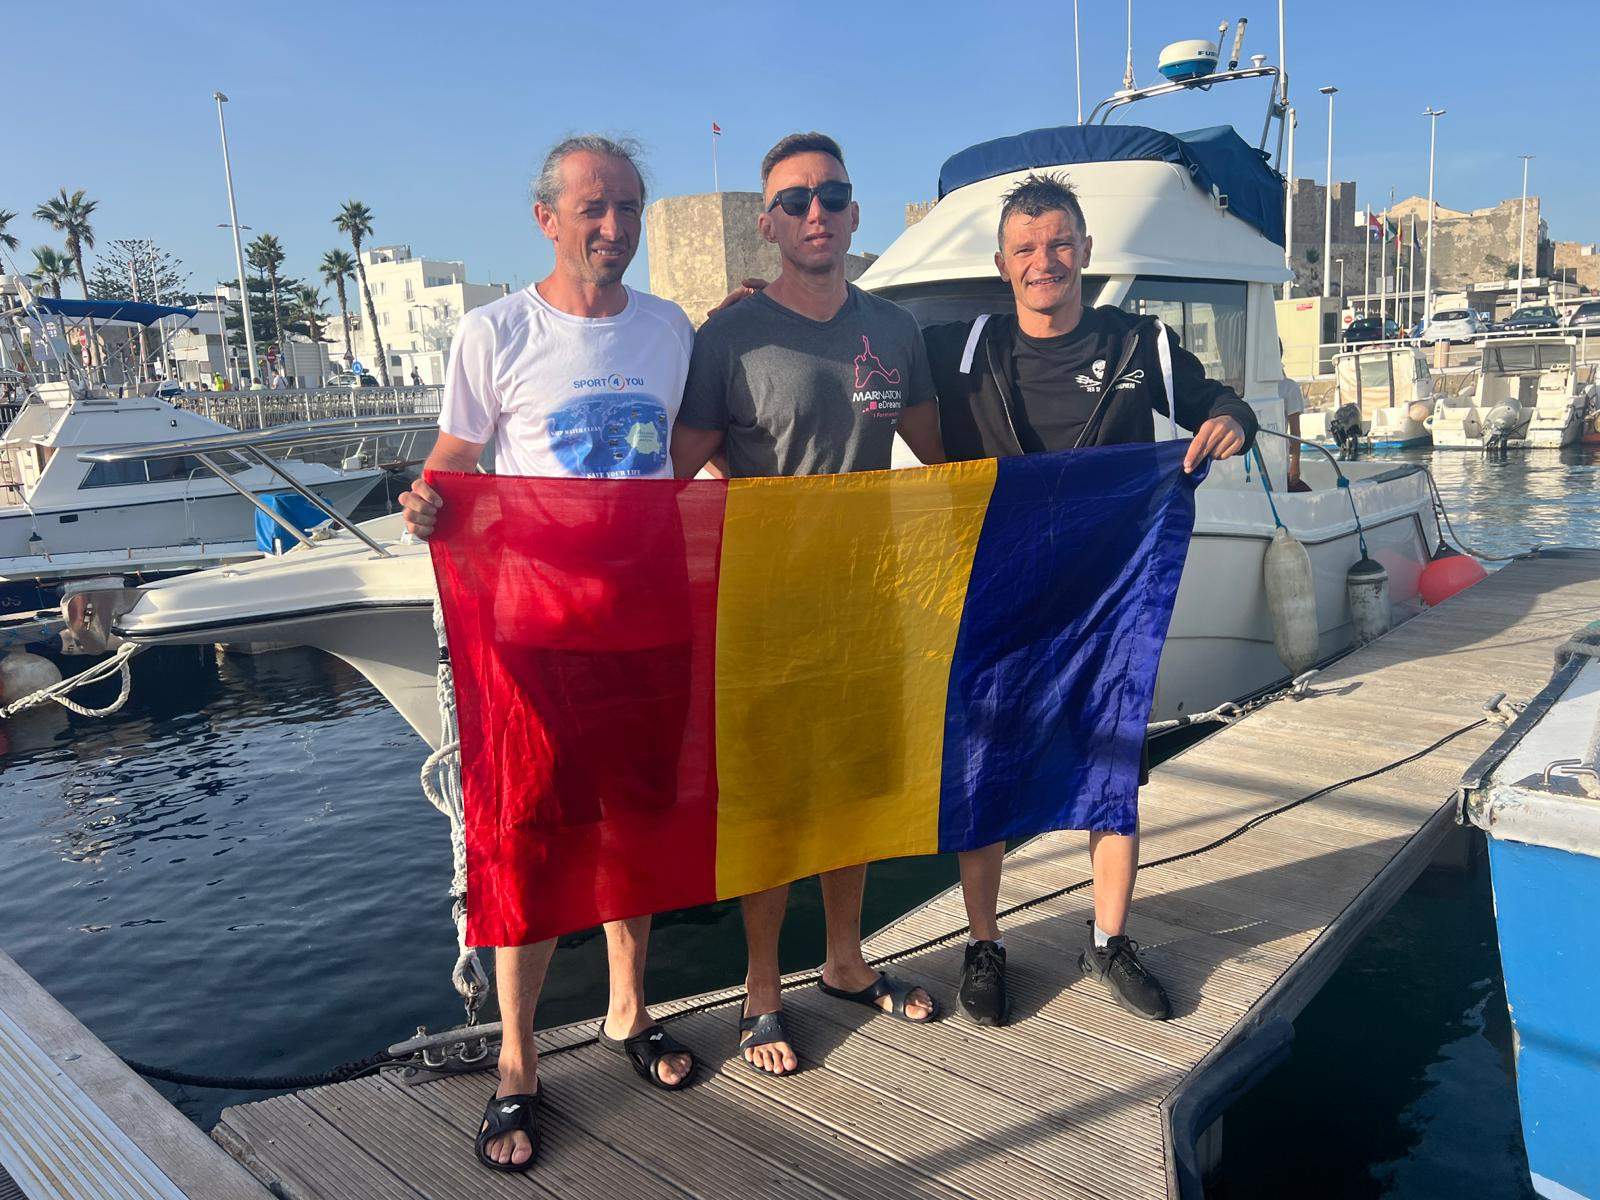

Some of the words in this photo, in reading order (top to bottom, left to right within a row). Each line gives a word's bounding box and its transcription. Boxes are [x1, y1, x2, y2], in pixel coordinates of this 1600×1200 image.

[573, 378, 608, 389] SPORT
[613, 377, 620, 386] 4
[625, 376, 645, 386] YOU
[852, 390, 902, 401] MARNATON
[607, 470, 626, 478] YOUR
